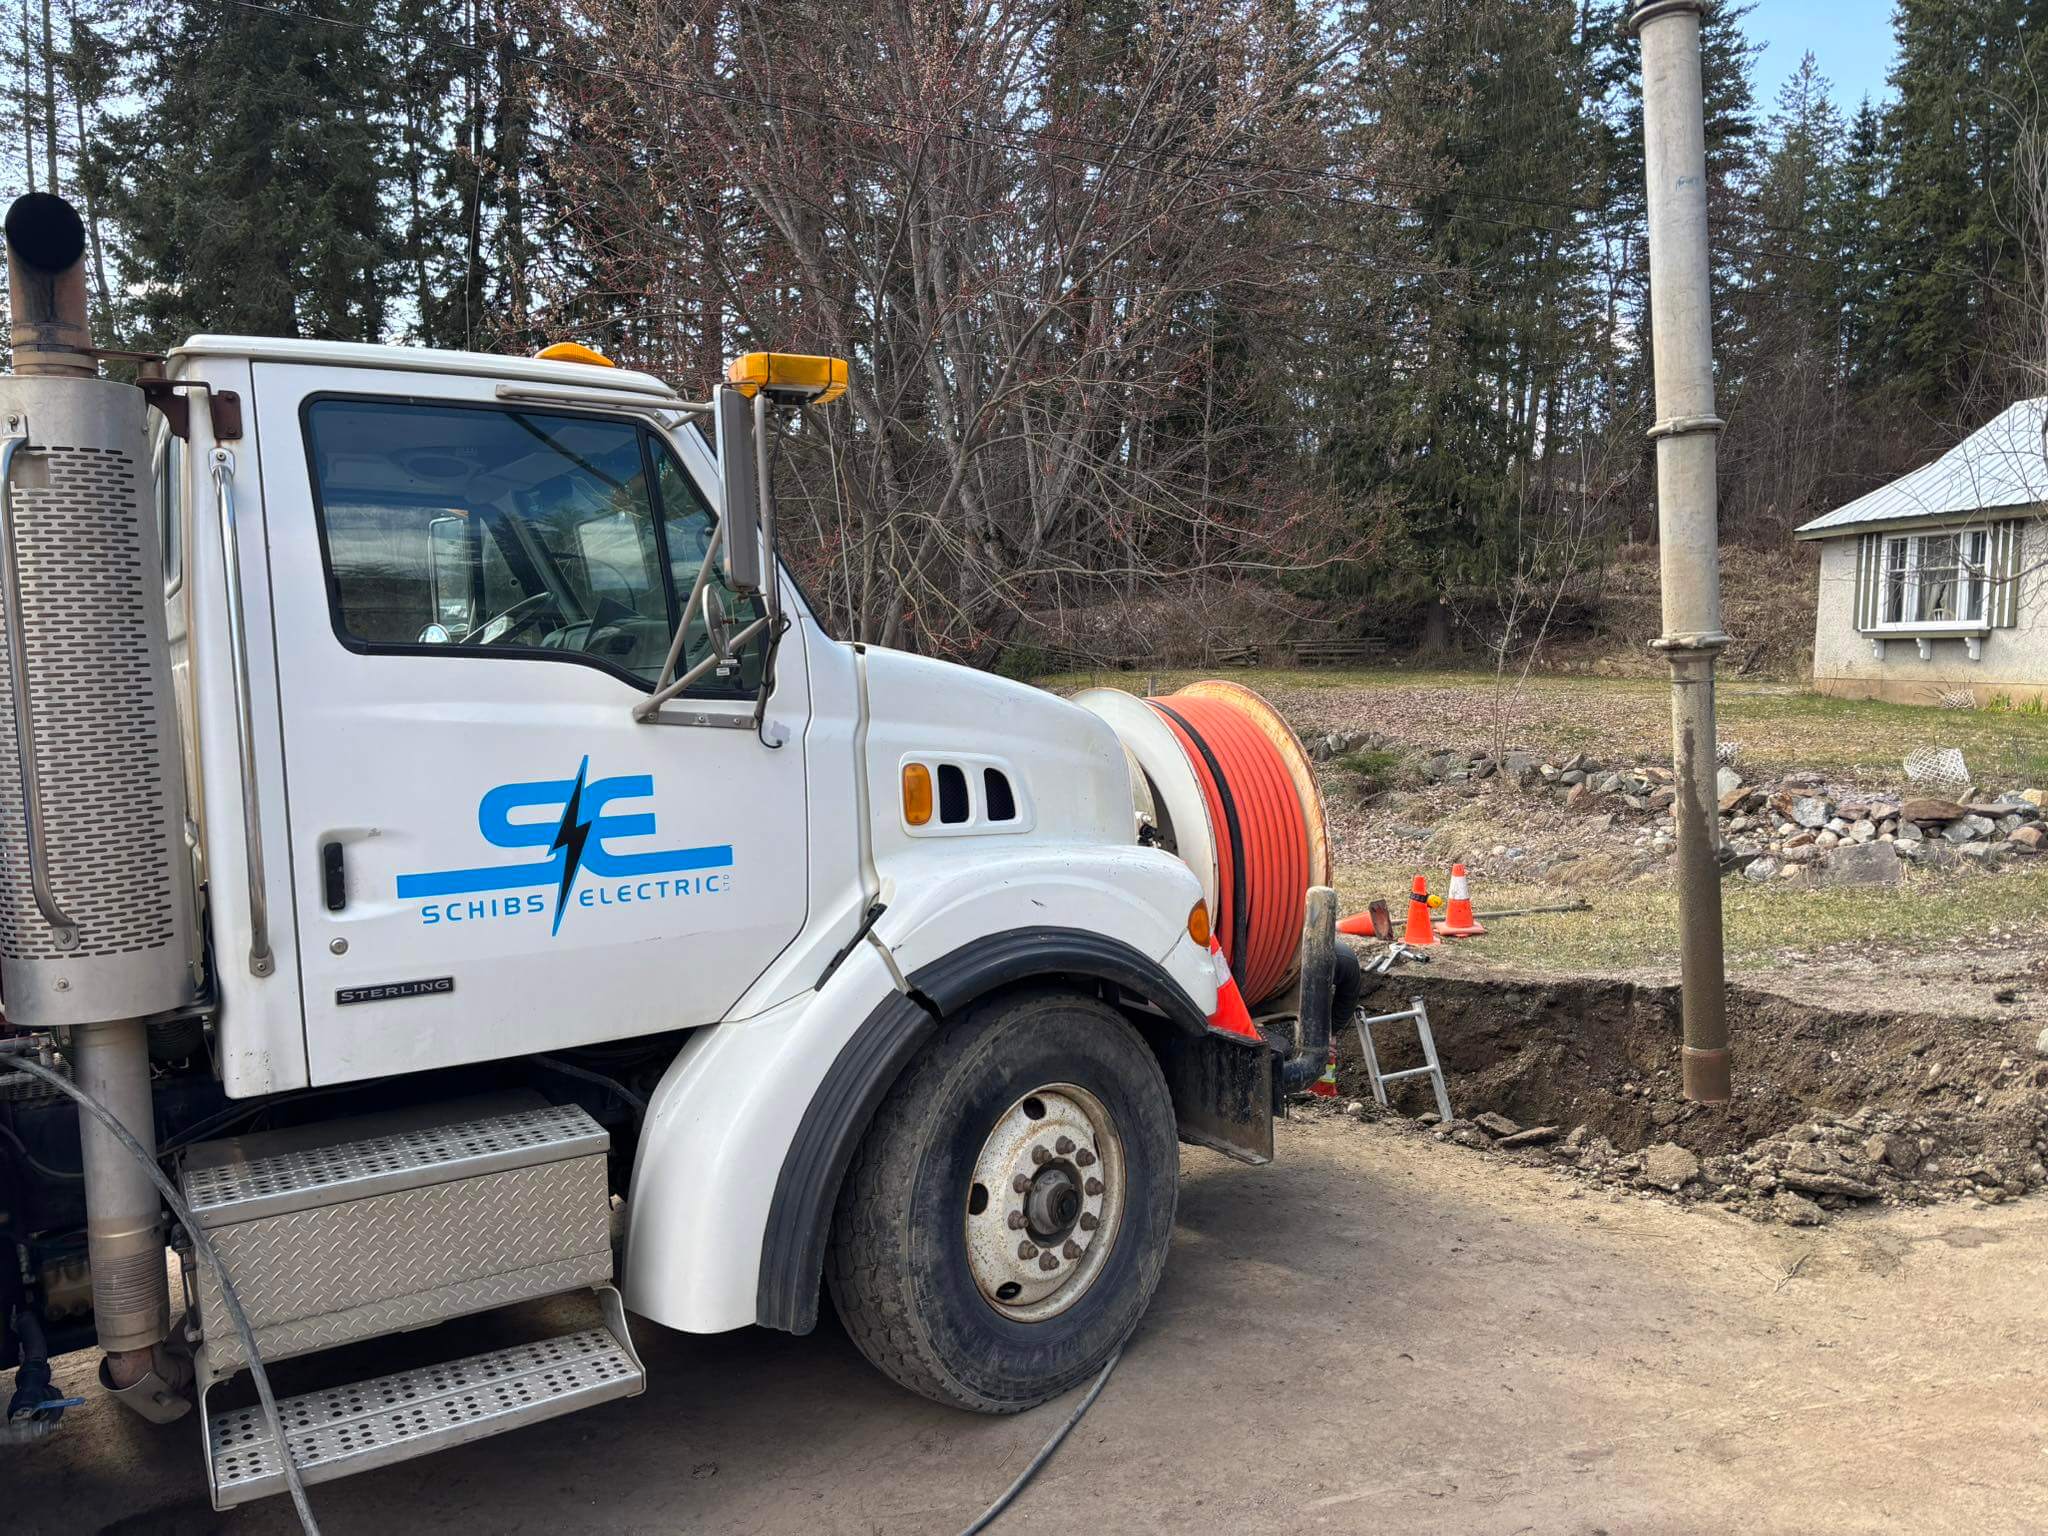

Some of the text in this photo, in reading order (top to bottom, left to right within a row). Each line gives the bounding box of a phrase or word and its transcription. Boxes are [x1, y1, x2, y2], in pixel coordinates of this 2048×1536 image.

[722, 874, 730, 892] LTD
[421, 875, 720, 924] SCHIBS ELECTRIC
[341, 980, 450, 1001] STERLING
